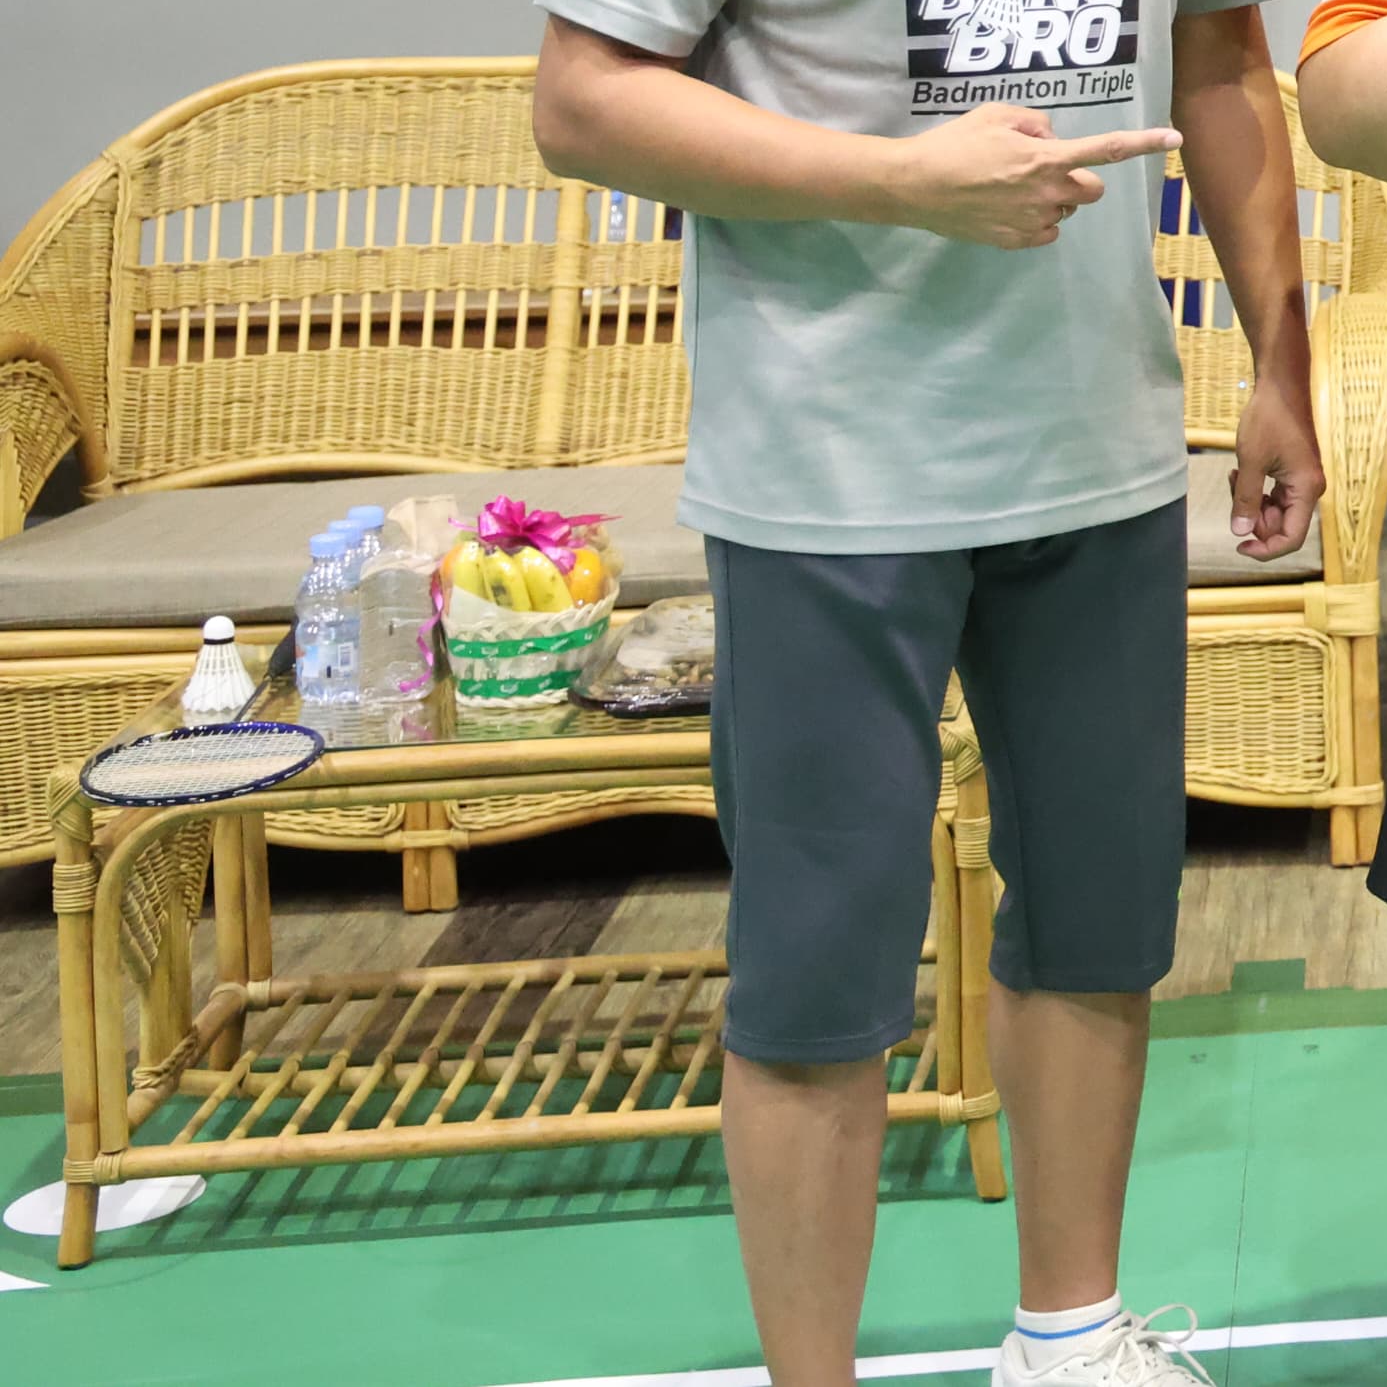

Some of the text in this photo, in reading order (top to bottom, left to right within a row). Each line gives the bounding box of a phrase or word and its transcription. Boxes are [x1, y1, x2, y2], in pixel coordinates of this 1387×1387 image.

[944, 4, 1122, 74] BRO
[912, 68, 1134, 104] Badminton Triple
